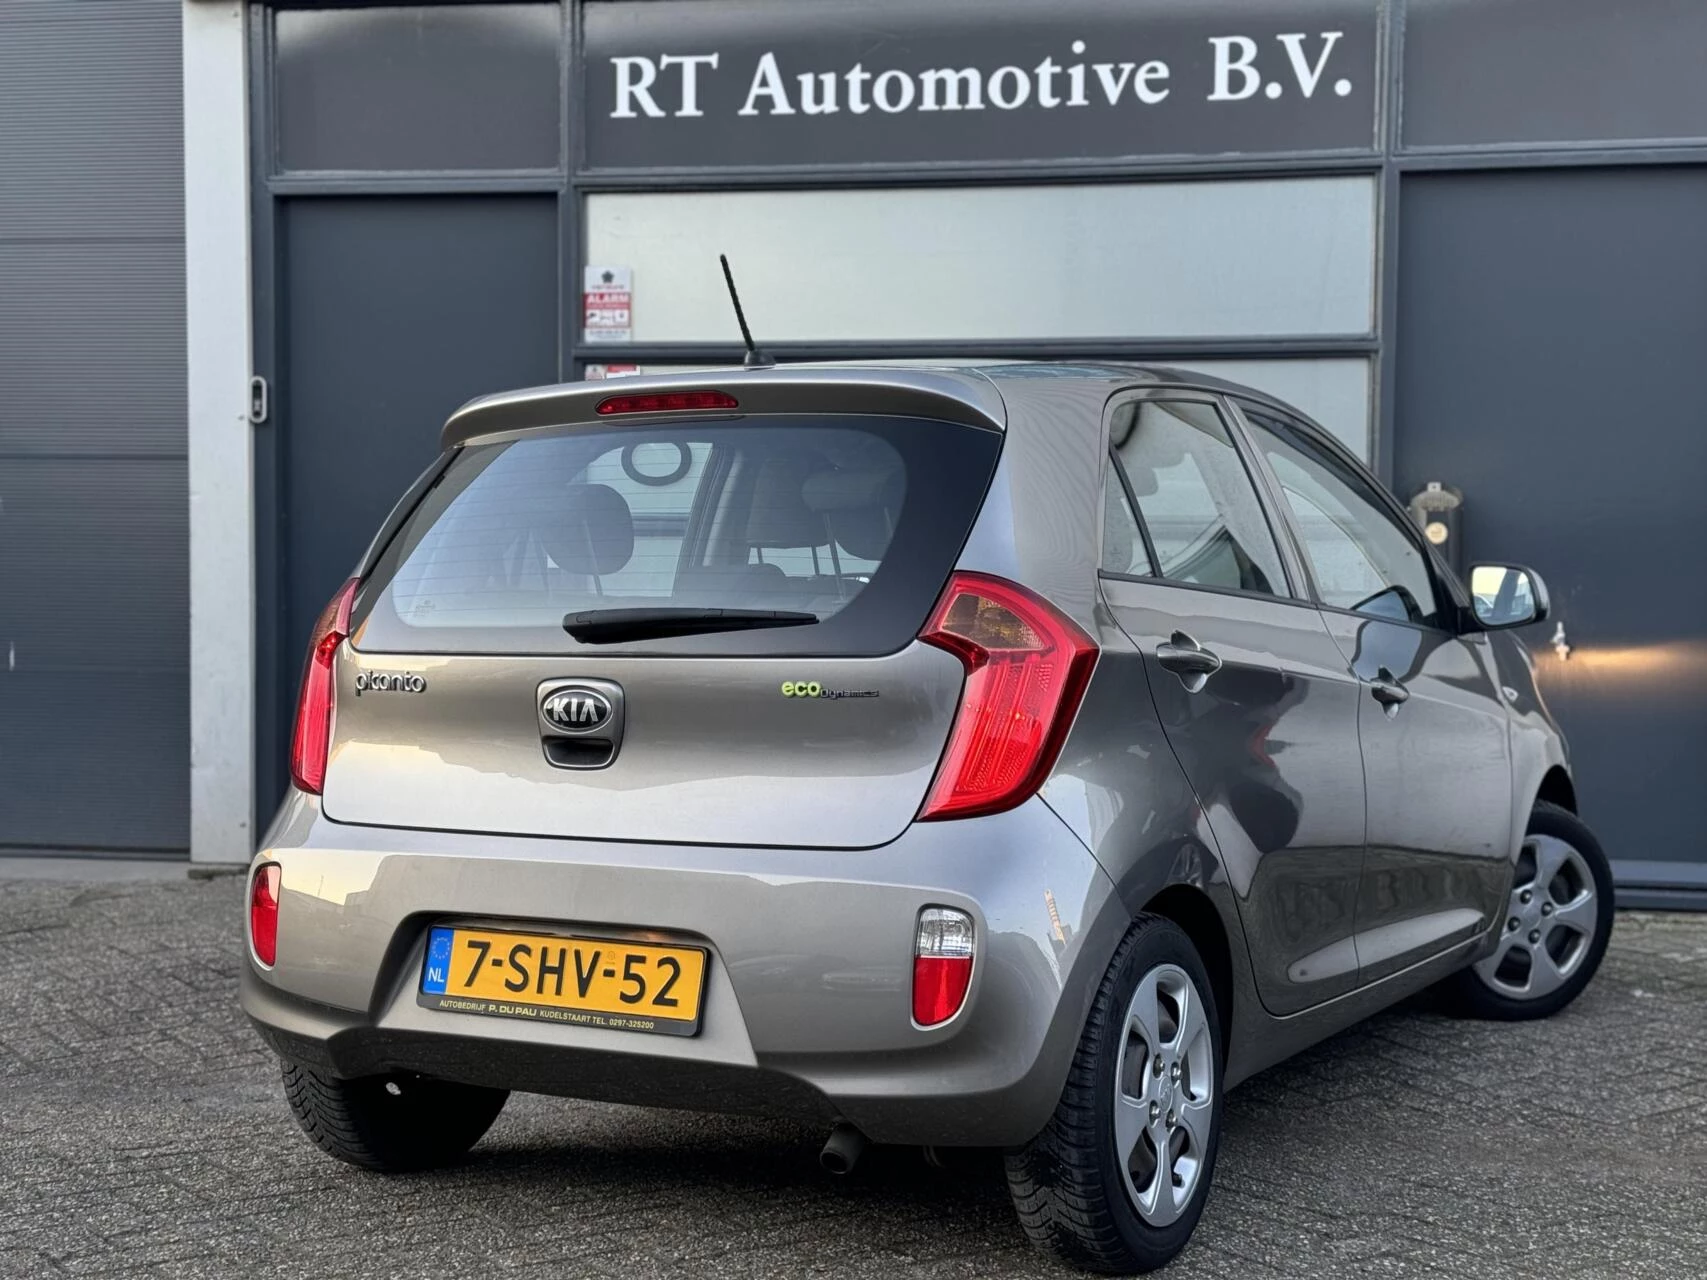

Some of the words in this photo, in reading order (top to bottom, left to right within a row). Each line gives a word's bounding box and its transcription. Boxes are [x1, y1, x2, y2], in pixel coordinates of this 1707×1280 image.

[610, 52, 718, 118] RT
[738, 40, 1170, 116] Automotive
[1207, 31, 1352, 101] B.V.
[587, 293, 630, 303] ALARM
[355, 670, 426, 696] picanto
[553, 697, 598, 723] KIA
[428, 967, 445, 983] NL
[464, 939, 682, 1008] 7-SHV-52
[439, 999, 486, 1011] AUTOBEDRIJF
[488, 1004, 498, 1013] P.
[539, 1009, 590, 1023] KUDELSTAART
[608, 1018, 654, 1030] 0297-325200
